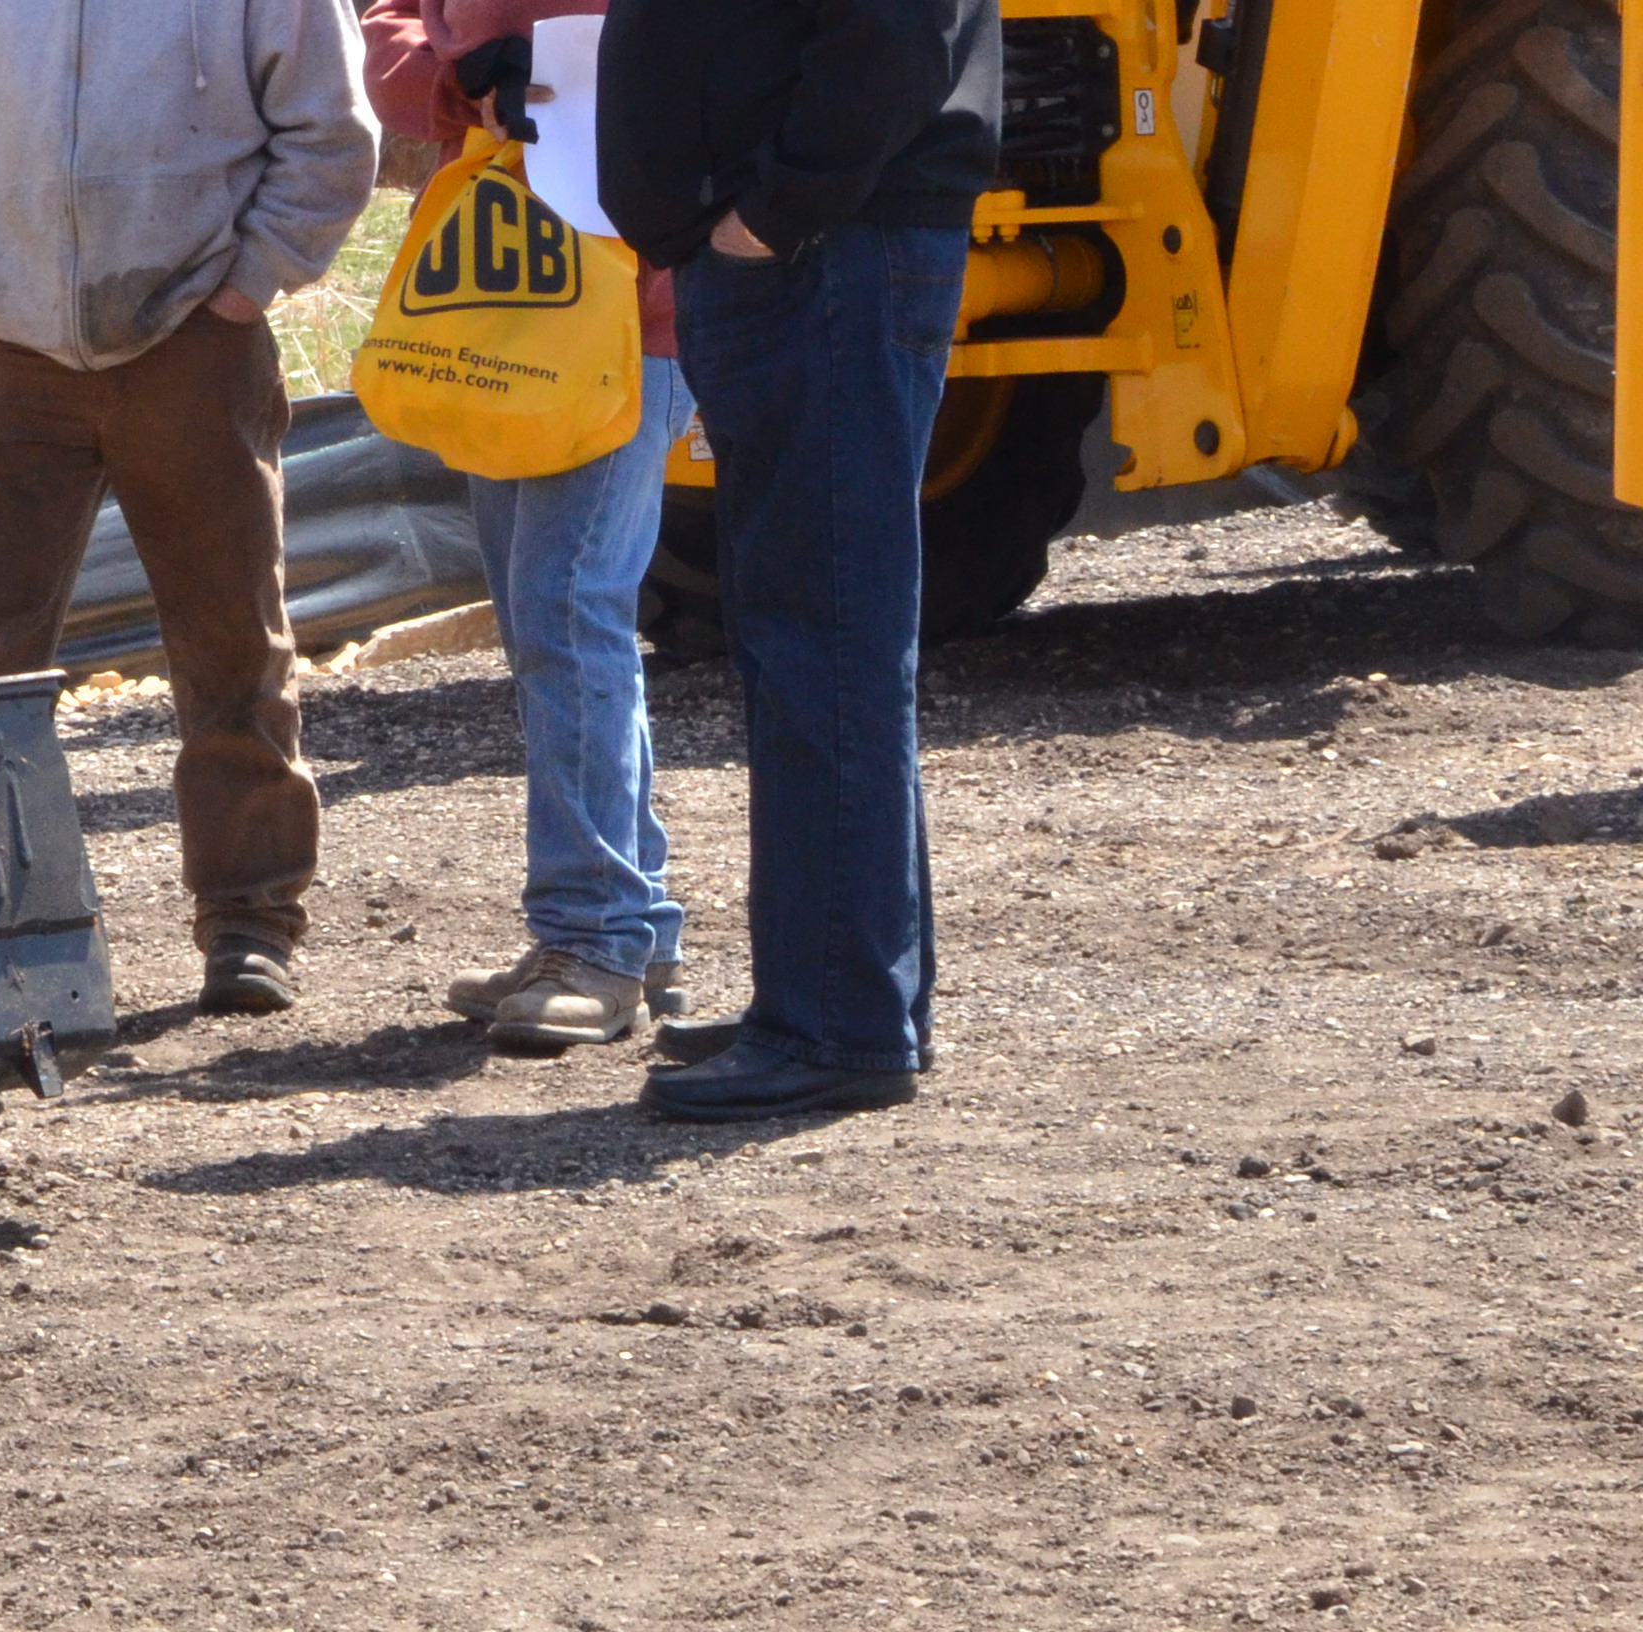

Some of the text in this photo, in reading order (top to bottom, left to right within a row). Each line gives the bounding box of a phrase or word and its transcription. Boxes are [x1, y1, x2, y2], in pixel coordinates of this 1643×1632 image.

[414, 177, 568, 297] JCB
[363, 335, 560, 385] onstruction Equipment
[377, 356, 510, 394] www.jcb.com
